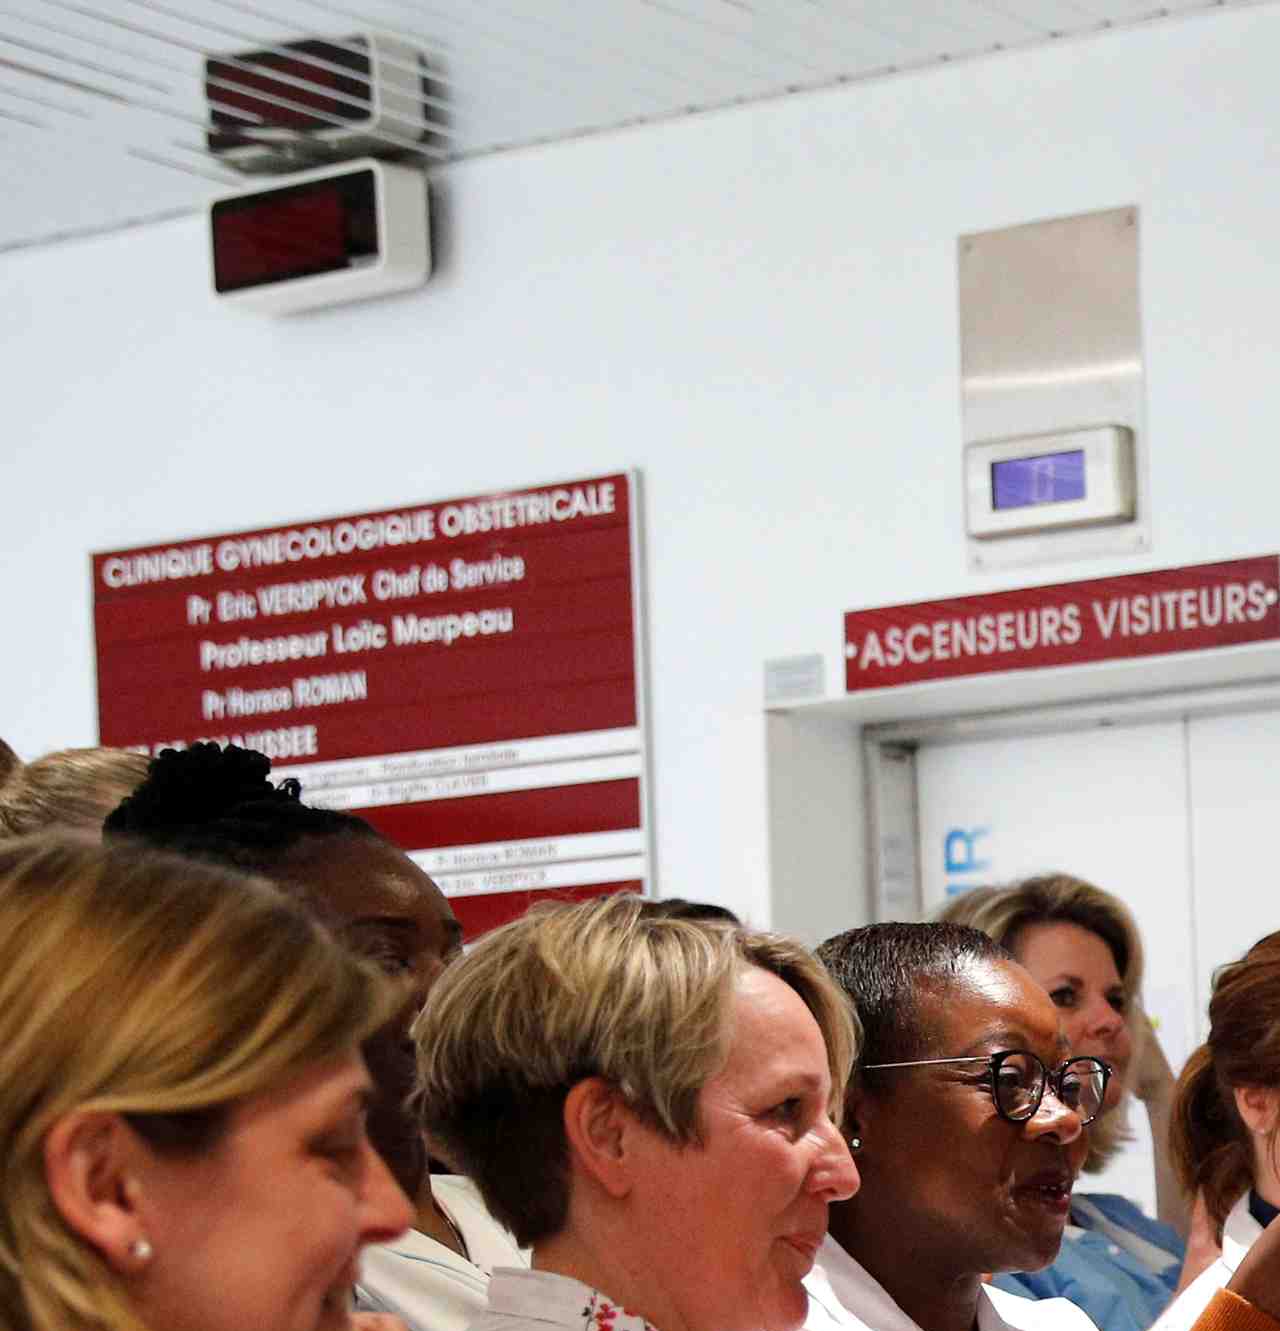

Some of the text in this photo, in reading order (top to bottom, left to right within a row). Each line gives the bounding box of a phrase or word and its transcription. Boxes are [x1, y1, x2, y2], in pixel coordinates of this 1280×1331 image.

[103, 483, 615, 588] CLINIQUE GYNECOLOGIQUE OBSTETRICALE
[187, 595, 212, 625] Pr
[217, 590, 257, 622] Eric
[372, 564, 421, 600] Chef
[422, 562, 449, 594] de
[450, 555, 525, 590] Service
[858, 580, 1266, 670] ASCENSEURS VISITEURS
[201, 630, 329, 671] Professeur
[392, 607, 514, 645] Marpeau
[202, 690, 225, 720] Pr
[293, 670, 368, 706] ROMAN
